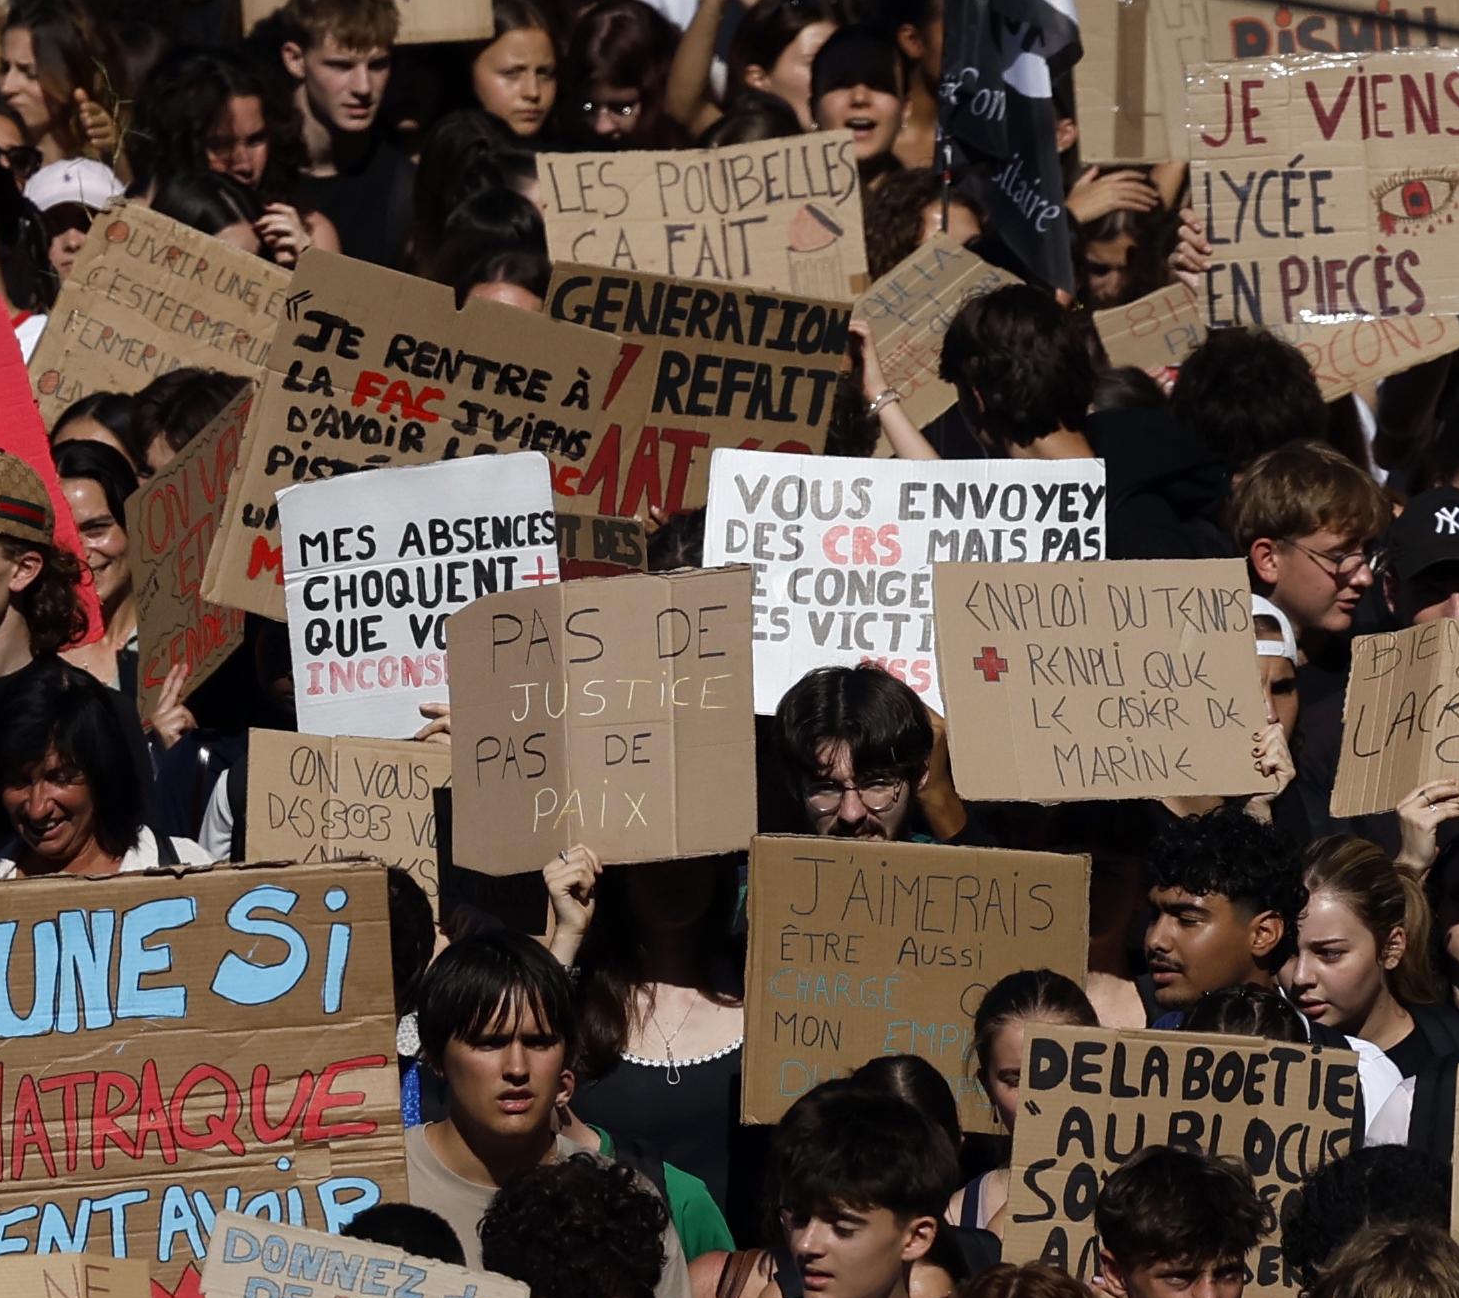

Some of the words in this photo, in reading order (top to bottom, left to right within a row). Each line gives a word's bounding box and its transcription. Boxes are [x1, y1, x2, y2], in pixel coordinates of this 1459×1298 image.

[1200, 80, 1267, 148] JE
[546, 156, 631, 220] LES
[656, 137, 857, 208] POUBELLES
[1204, 153, 1336, 246] LYCÉE
[1206, 259, 1264, 328] EN
[281, 359, 335, 396] LA
[351, 368, 446, 423] FAC
[383, 333, 554, 402] RENTRE
[652, 349, 836, 427] REFAIT
[734, 473, 874, 521] VOUS
[300, 523, 376, 568] MES
[397, 510, 557, 557] ABSENCES
[724, 518, 805, 560] DES
[822, 524, 902, 567] CRS
[302, 555, 518, 613] CHOQUENT
[304, 615, 388, 658] QUE
[491, 607, 605, 673] PAS
[656, 606, 730, 661] DE
[475, 731, 548, 786] PAS
[604, 731, 653, 767] DE
[1053, 735, 1198, 788] MARINE
[779, 926, 865, 965] ÊTRE
[774, 1010, 842, 1051] MON
